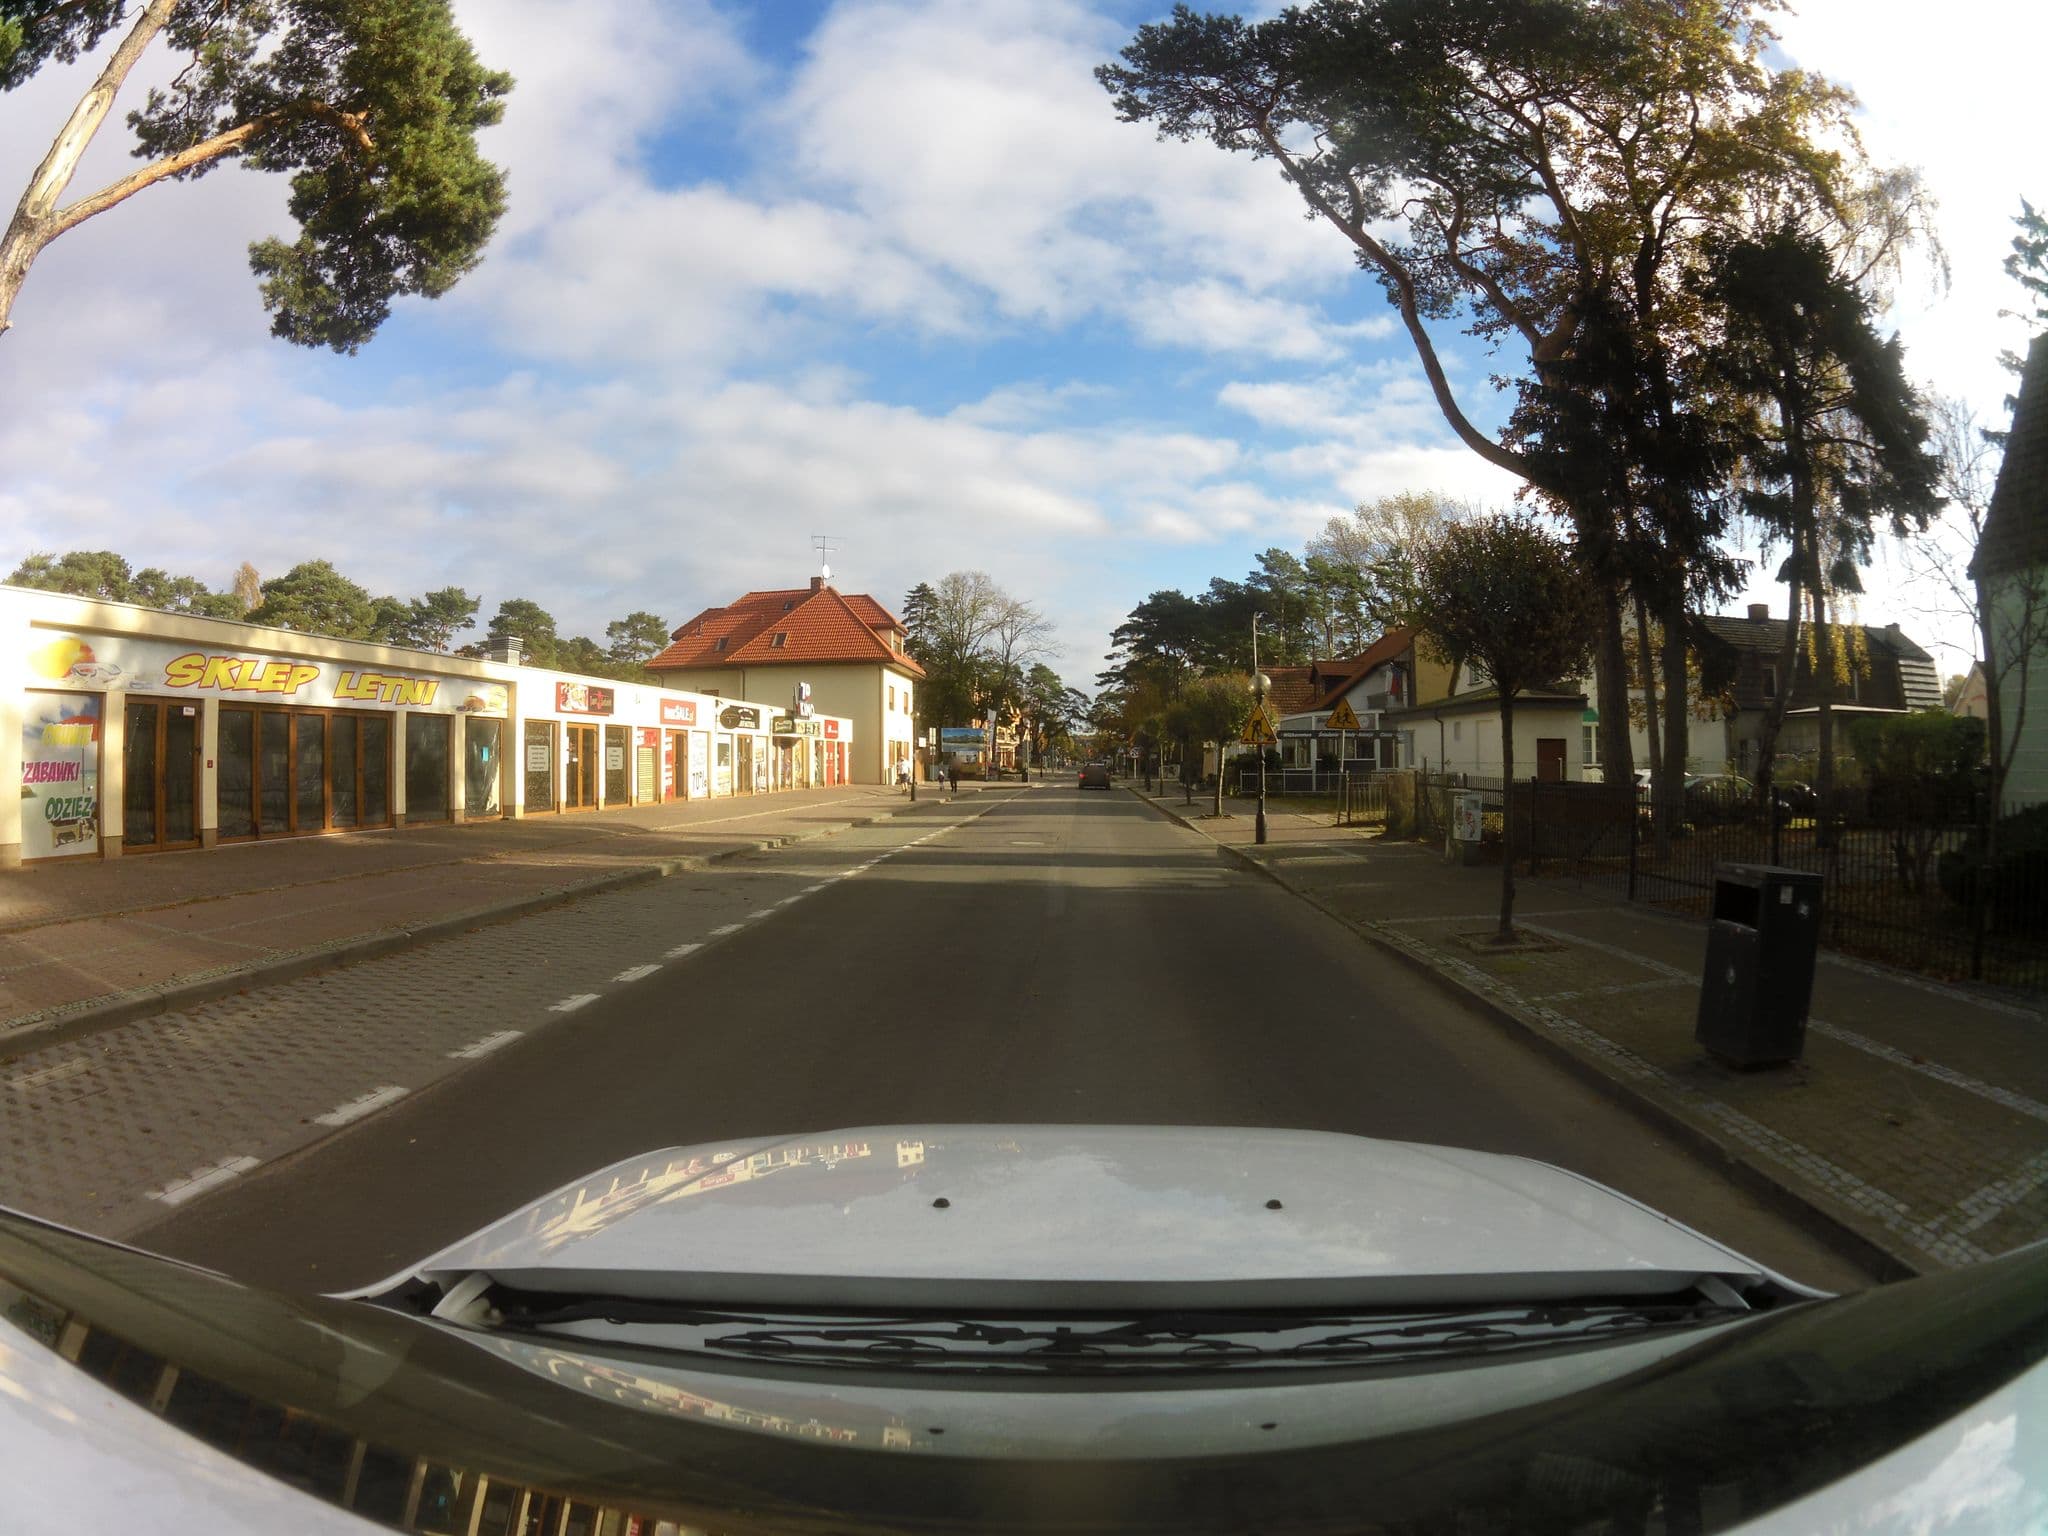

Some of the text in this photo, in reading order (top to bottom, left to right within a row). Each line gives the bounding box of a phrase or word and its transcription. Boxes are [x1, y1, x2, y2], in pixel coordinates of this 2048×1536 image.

[164, 653, 440, 705] SKLEP LETNI
[23, 761, 80, 784] ZABAWKI
